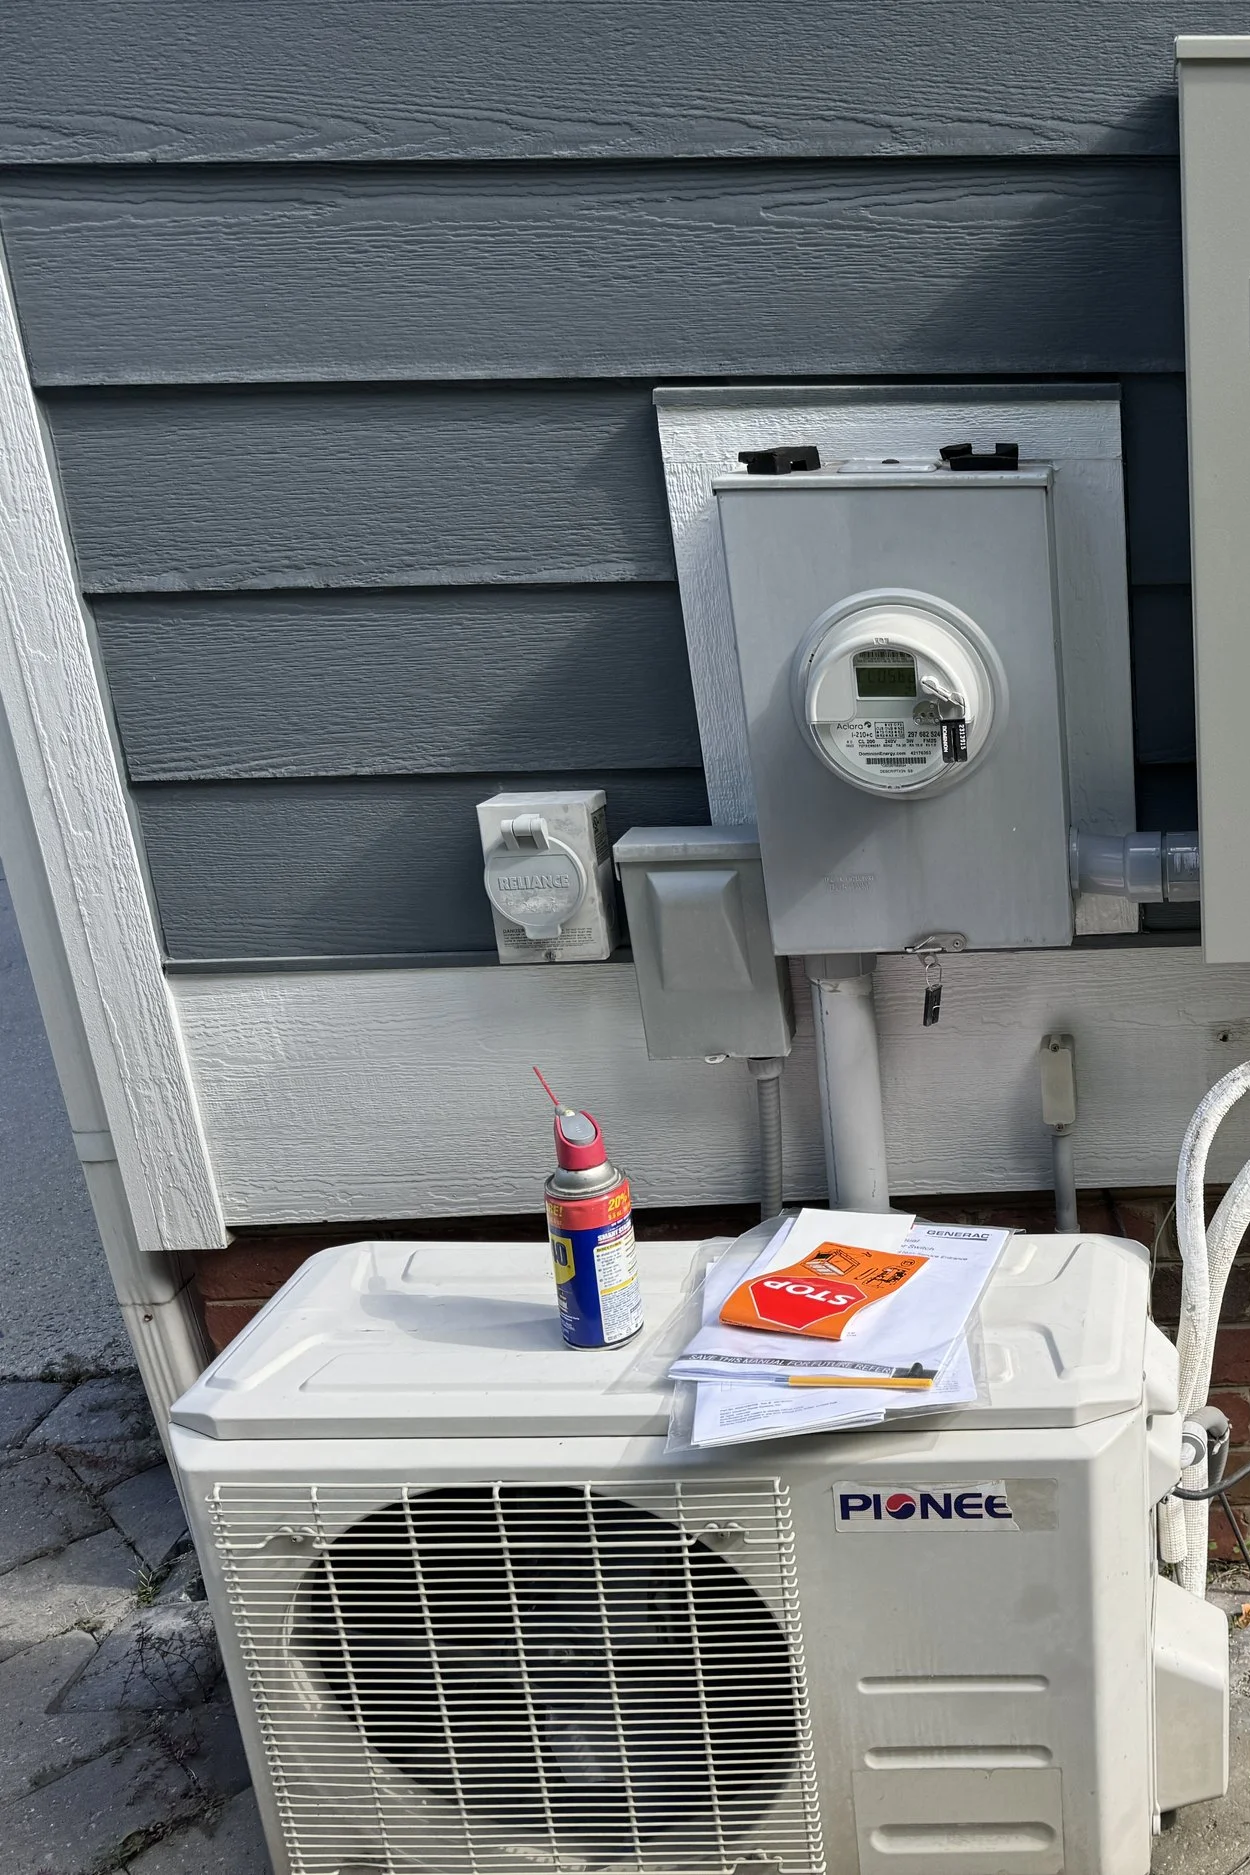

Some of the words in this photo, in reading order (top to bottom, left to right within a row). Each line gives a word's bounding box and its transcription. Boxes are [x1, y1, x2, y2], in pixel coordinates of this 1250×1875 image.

[836, 722, 864, 730] Aclara
[498, 873, 570, 891] RELIANCE
[926, 1229, 990, 1240] GENERAC
[763, 1280, 856, 1306] STOP
[743, 1357, 786, 1366] MANUAL
[811, 1361, 853, 1370] FUTURE
[839, 1493, 1013, 1520] PIONEE
